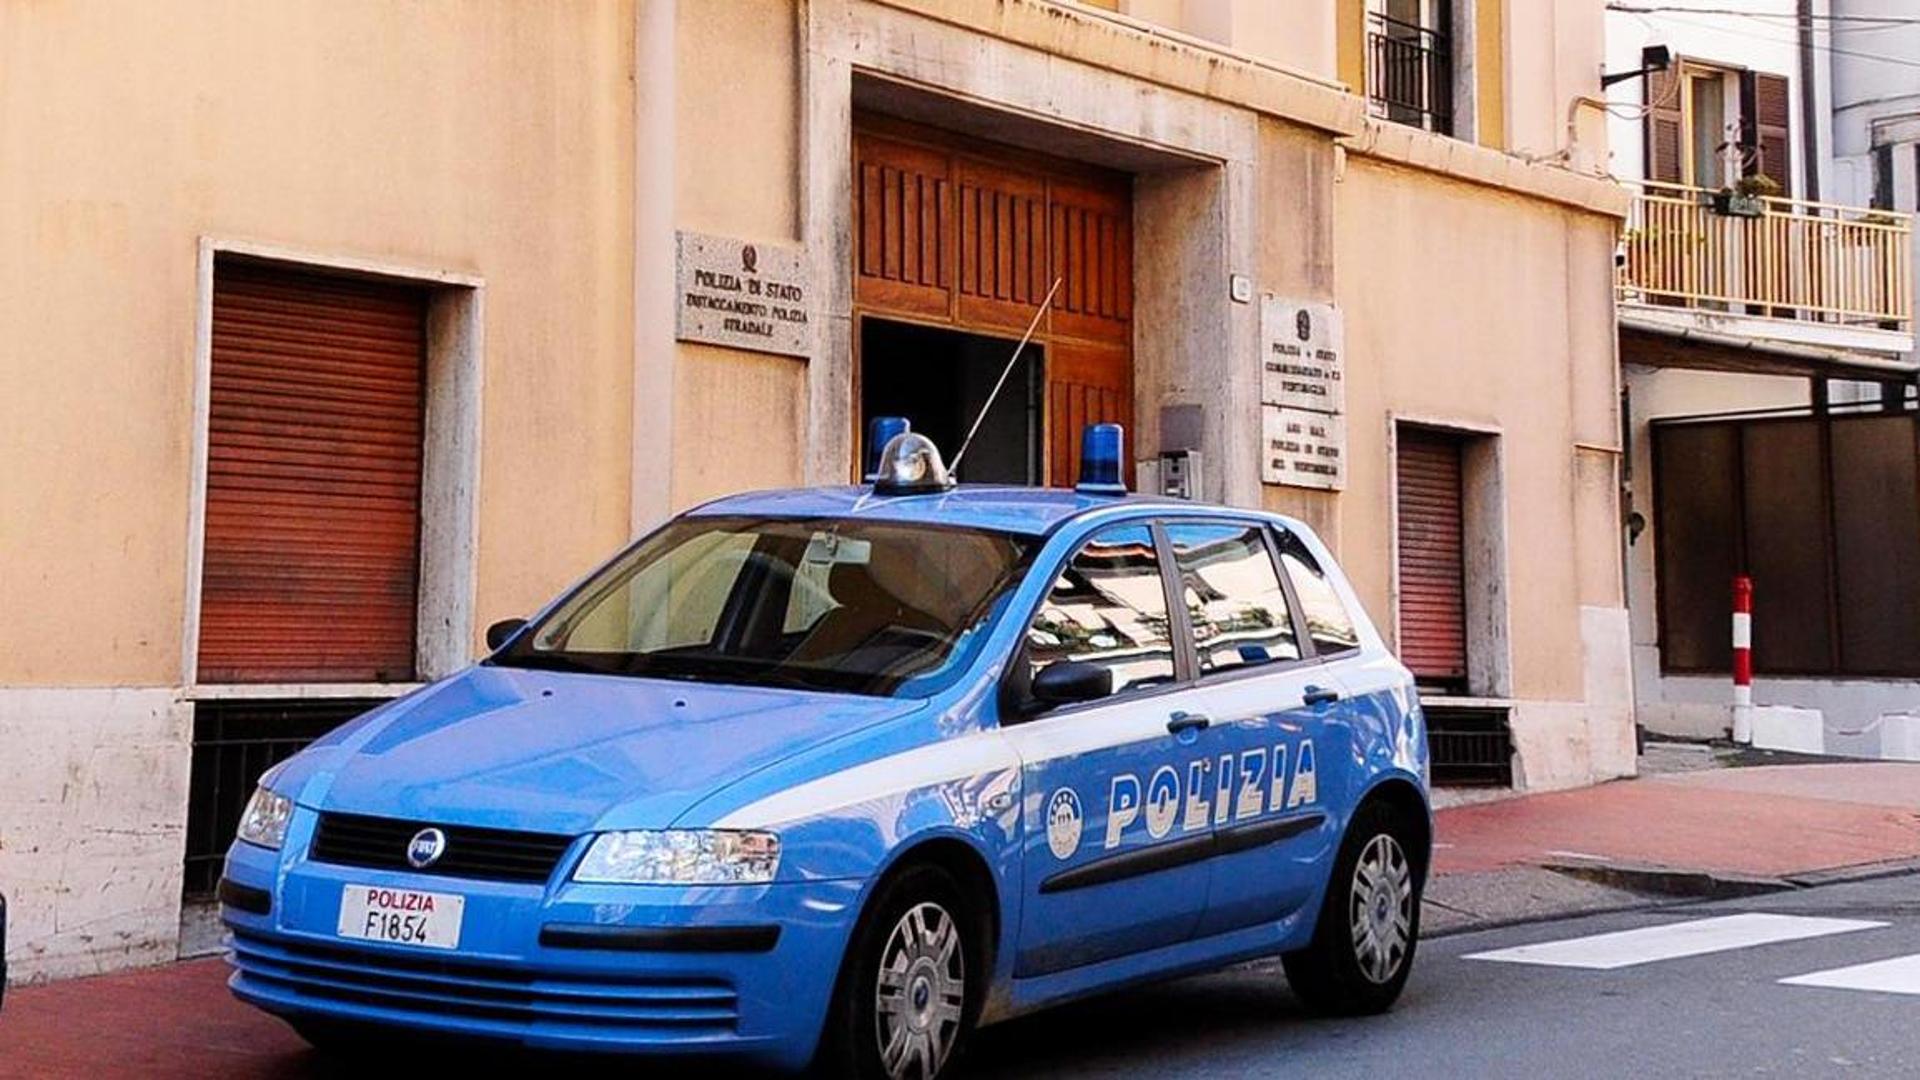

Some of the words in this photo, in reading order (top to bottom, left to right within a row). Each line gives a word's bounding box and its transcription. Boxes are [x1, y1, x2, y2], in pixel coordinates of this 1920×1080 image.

[695, 270, 742, 292] POLIZIA
[748, 278, 762, 296] DI
[766, 283, 802, 301] STATO
[724, 319, 773, 336] STRADALE
[772, 306, 808, 323] POLIZIA
[1105, 739, 1317, 849] POLIZIA
[367, 889, 435, 912] POLIZIA
[364, 911, 427, 943] F1854
